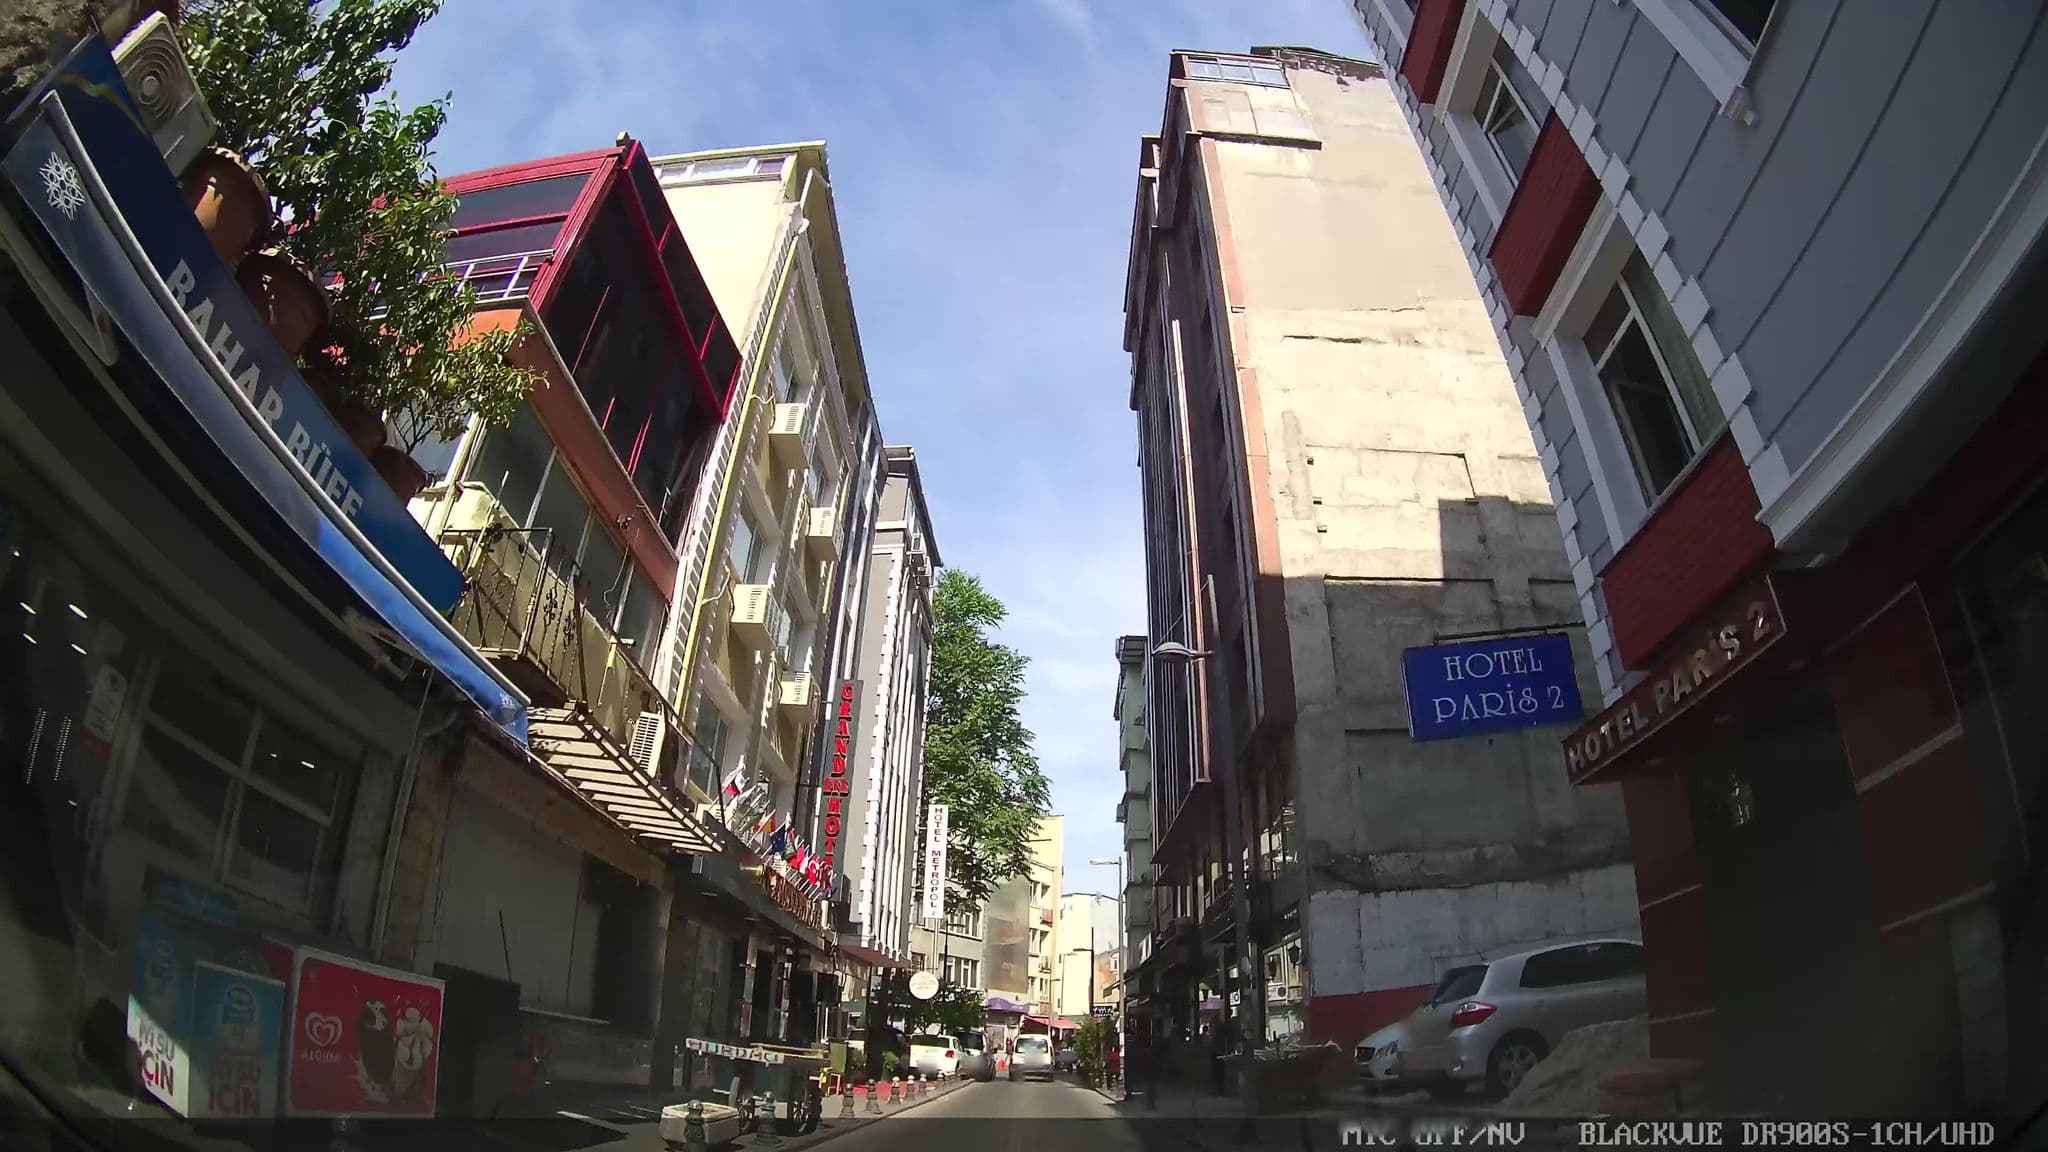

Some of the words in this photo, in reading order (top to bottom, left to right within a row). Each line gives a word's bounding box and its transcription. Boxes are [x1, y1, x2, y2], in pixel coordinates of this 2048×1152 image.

[1442, 648, 1543, 681] HOTEL
[1568, 702, 1649, 771] HOTEL
[1747, 601, 1770, 642] 2
[1432, 683, 1538, 723] PARİS
[1547, 686, 1565, 709] 2
[832, 682, 855, 777] GRAND
[934, 807, 943, 843] HOTEL
[930, 850, 942, 908] METROPOL
